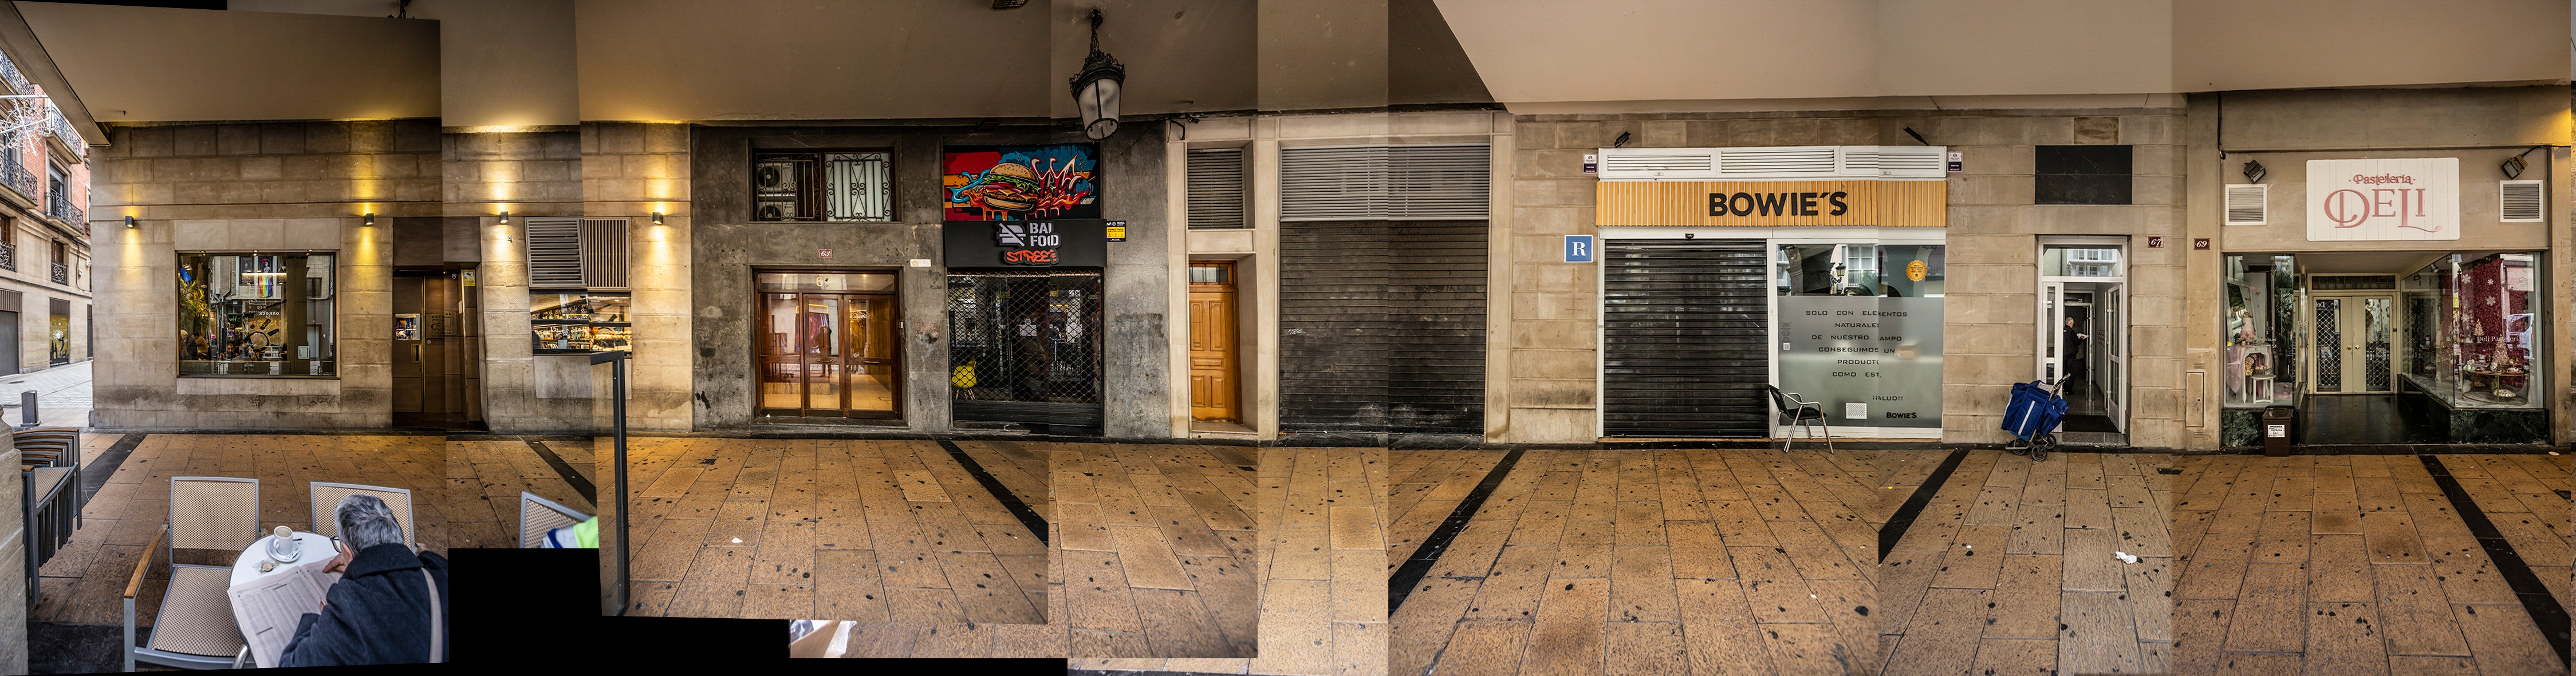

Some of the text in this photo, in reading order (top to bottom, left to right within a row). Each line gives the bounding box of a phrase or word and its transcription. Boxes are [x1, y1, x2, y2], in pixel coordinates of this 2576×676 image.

[2353, 173, 2413, 185] Pastelería
[2324, 188, 2442, 232] DELI
[1572, 242, 1586, 256] R
